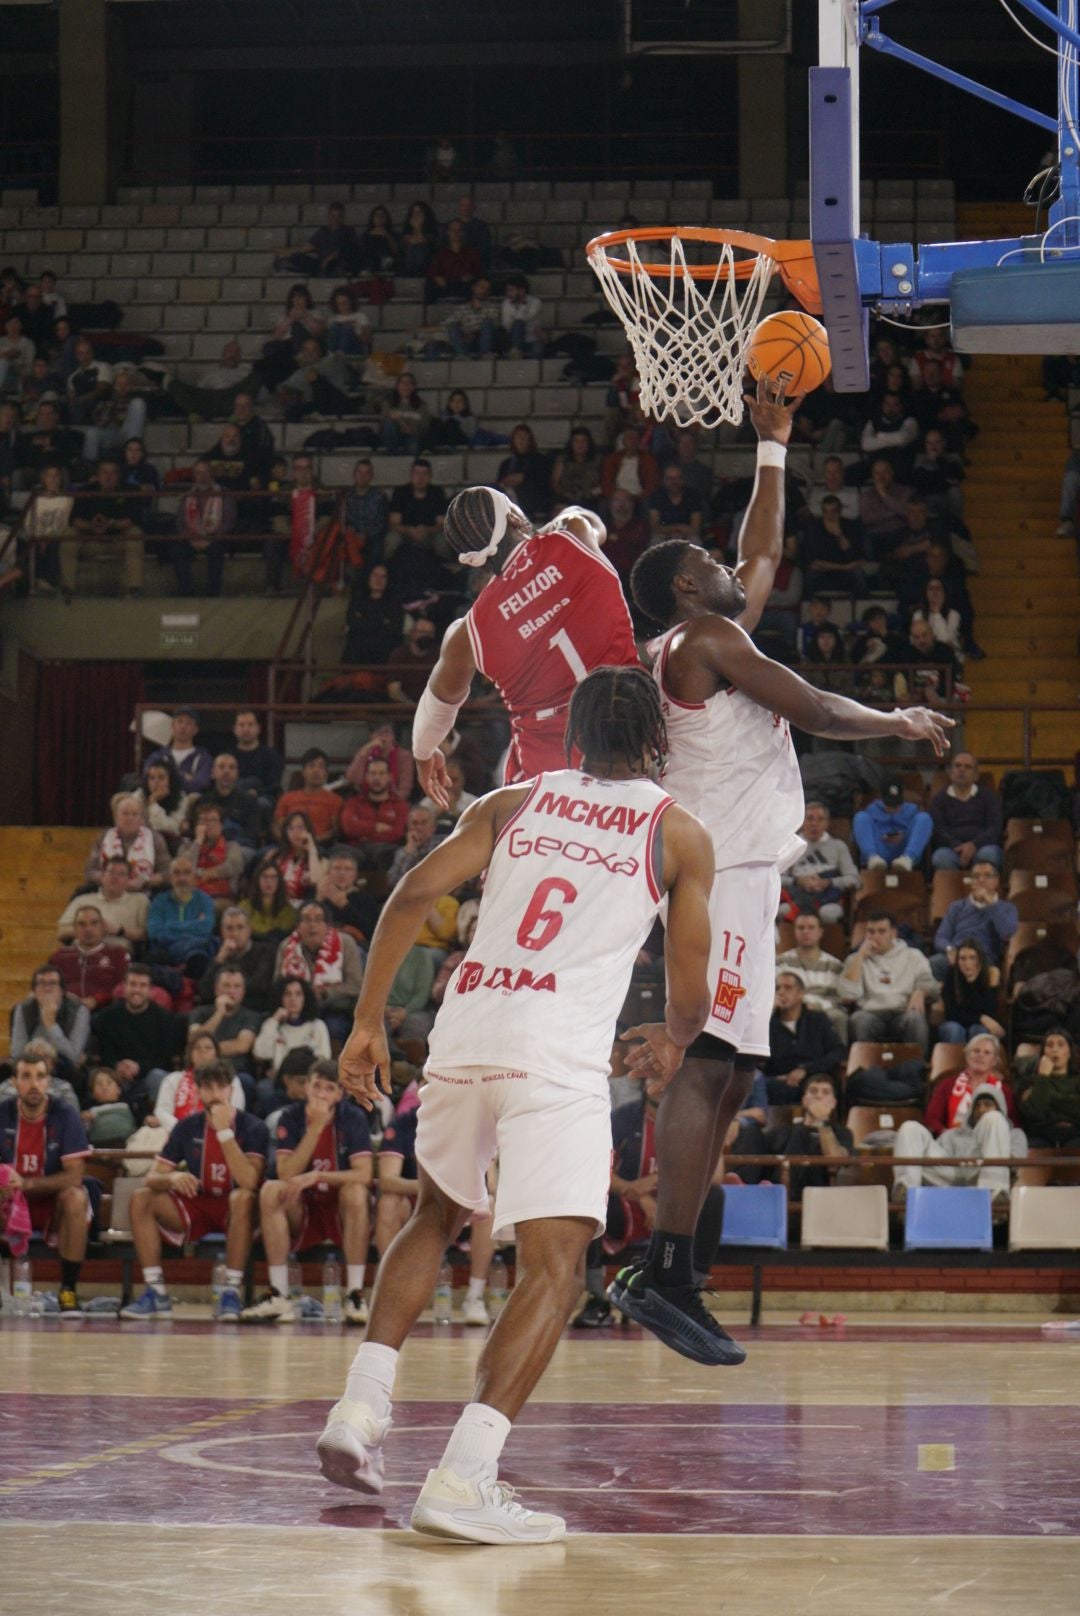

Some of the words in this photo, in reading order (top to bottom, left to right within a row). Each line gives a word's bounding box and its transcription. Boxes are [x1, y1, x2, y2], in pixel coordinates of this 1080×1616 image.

[498, 565, 563, 620] FELIZOR
[534, 791, 650, 836] MCKAY
[508, 828, 639, 877] Geoxa
[516, 876, 578, 952] 6
[723, 930, 746, 967] 17
[22, 1154, 38, 1174] 13
[210, 1163, 227, 1182] 12
